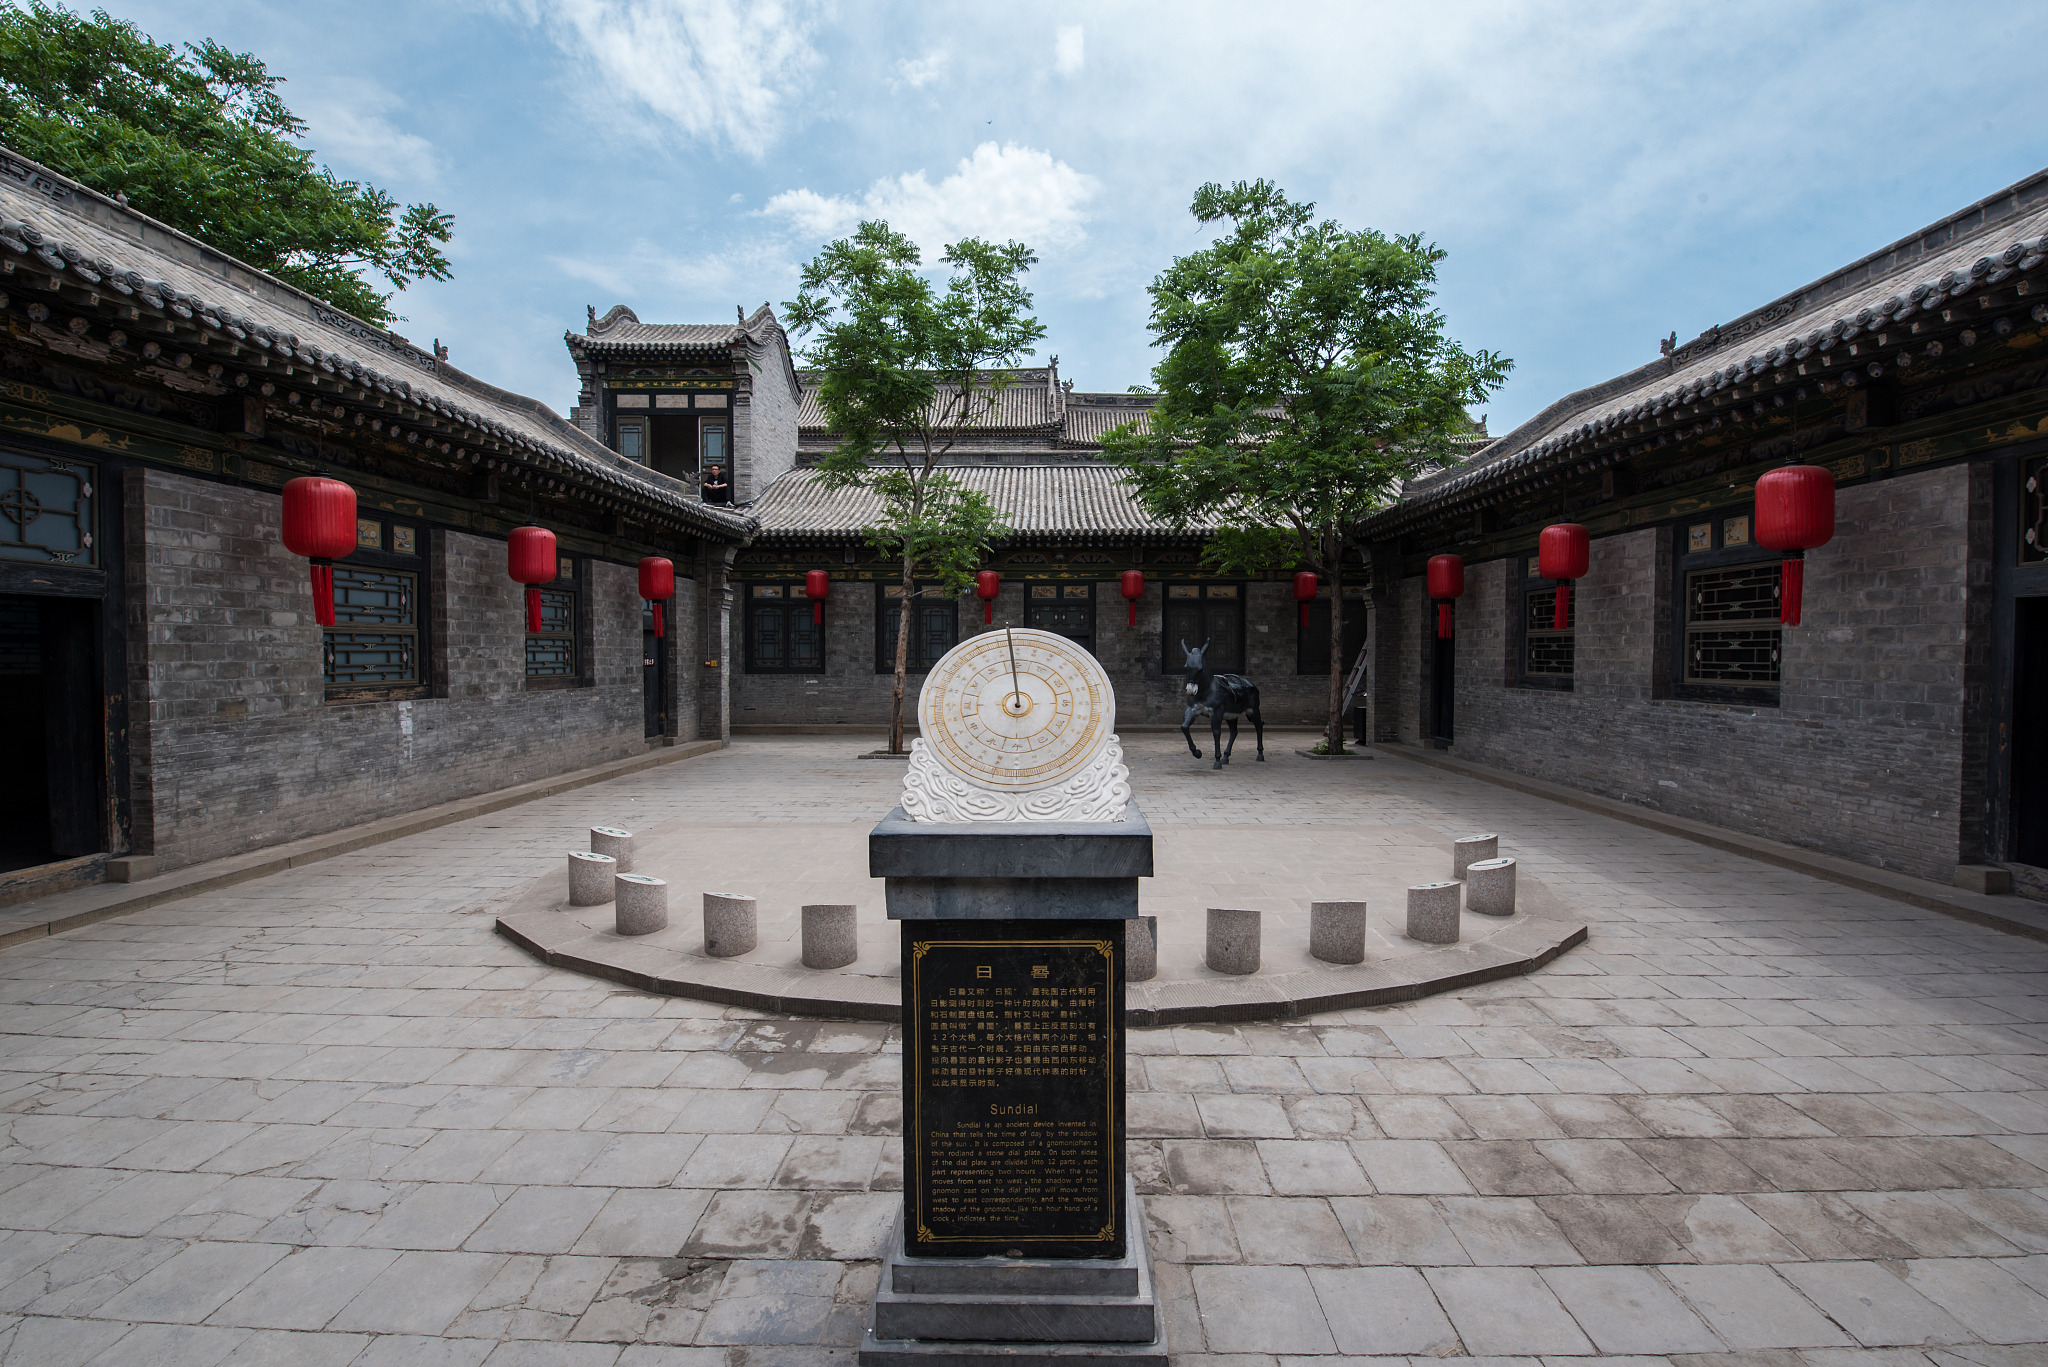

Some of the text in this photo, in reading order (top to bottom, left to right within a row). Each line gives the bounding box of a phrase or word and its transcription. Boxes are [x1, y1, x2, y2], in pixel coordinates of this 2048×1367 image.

[990, 1103, 1038, 1115] Sundial
[956, 1121, 981, 1129] Sundial
[984, 1121, 990, 1129] is
[1033, 1120, 1054, 1128] device
[1058, 1120, 1086, 1128] invented
[1030, 1131, 1042, 1139] day
[941, 1140, 953, 1148] the
[992, 1139, 1025, 1148] composed
[1028, 1139, 1036, 1147] of
[1048, 1148, 1058, 1156] On
[931, 1158, 939, 1166] of
[971, 1158, 988, 1167] plate
[1004, 1158, 1028, 1166] divided
[931, 1167, 946, 1177] part
[950, 1168, 994, 1177] representing
[1044, 1167, 1066, 1175] When
[1069, 1167, 1082, 1175] the
[957, 1177, 974, 1185] from
[1030, 1177, 1042, 1185] the
[1075, 1176, 1083, 1184] of
[931, 1188, 960, 1196] gnomon
[1008, 1186, 1021, 1194] dial
[1024, 1186, 1041, 1195] plate
[1073, 1196, 1097, 1204] moving
[959, 1205, 967, 1213] of
[1083, 1204, 1091, 1212] of
